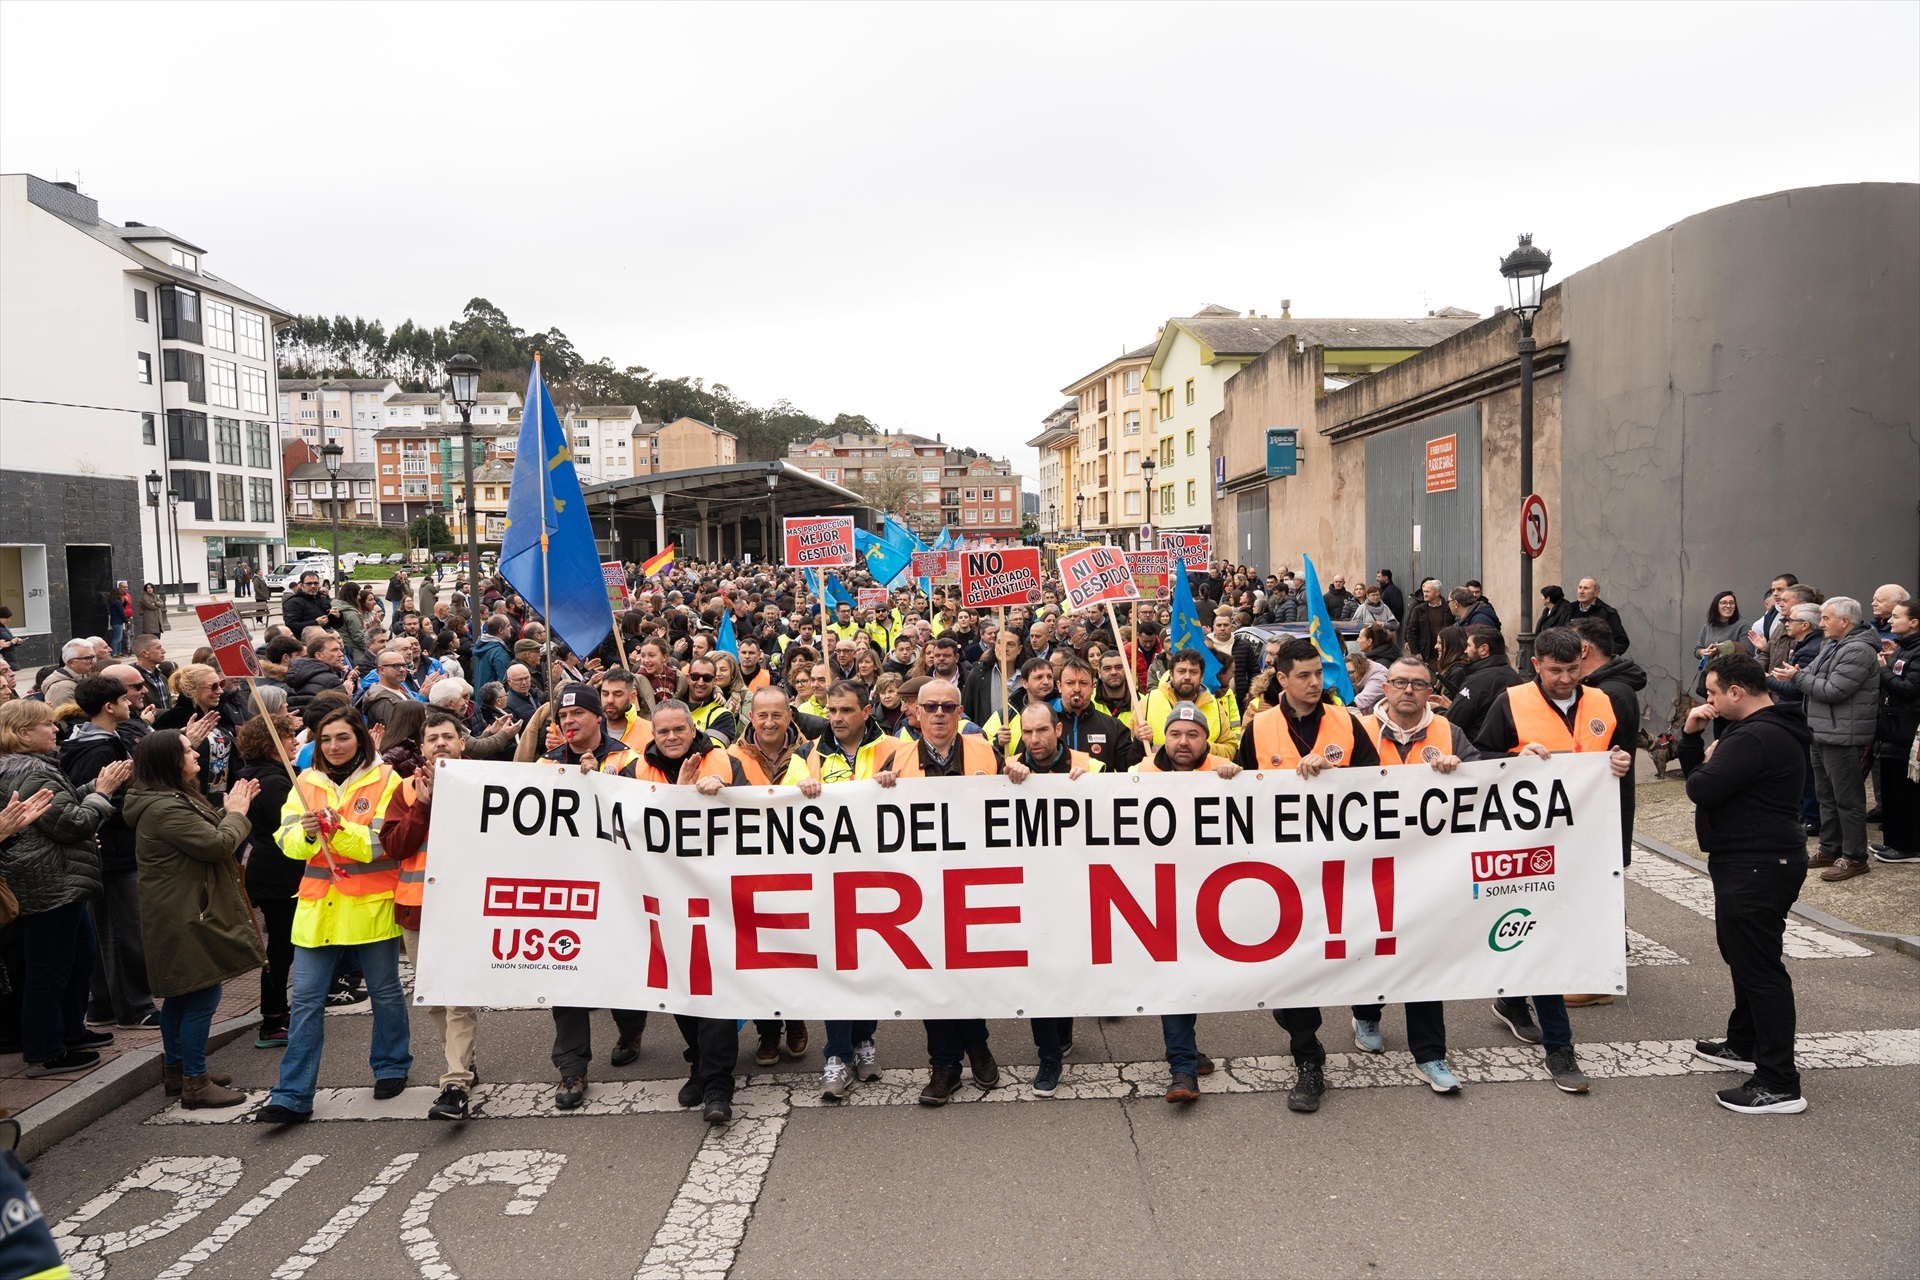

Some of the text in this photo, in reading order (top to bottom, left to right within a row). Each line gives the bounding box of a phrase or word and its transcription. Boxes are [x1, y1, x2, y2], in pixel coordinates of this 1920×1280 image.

[800, 530, 839, 546] MEJOR
[798, 542, 847, 561] GESTIÓN
[1138, 555, 1168, 564] ARREGLA
[1171, 545, 1203, 557] SOMOS
[969, 552, 1003, 576] NO
[1071, 548, 1114, 581] NI UN
[968, 578, 1038, 603] DE PLANTILLA
[971, 568, 1030, 591] AL VACIADO
[1070, 565, 1130, 606] DESPIDO
[480, 778, 1575, 857] POR LA DEFENSA DEL EMPLEO EN ENCE-CEASA
[1474, 852, 1529, 879] UGT
[488, 884, 596, 912] CCOO
[1486, 881, 1555, 898] SOMA FITAG
[643, 855, 1398, 996] ¡¡ERE NO!!
[1498, 920, 1537, 938] CSIF
[492, 928, 582, 962] USO
[491, 961, 578, 972] UNIÓN SINDICAL OBRERA
